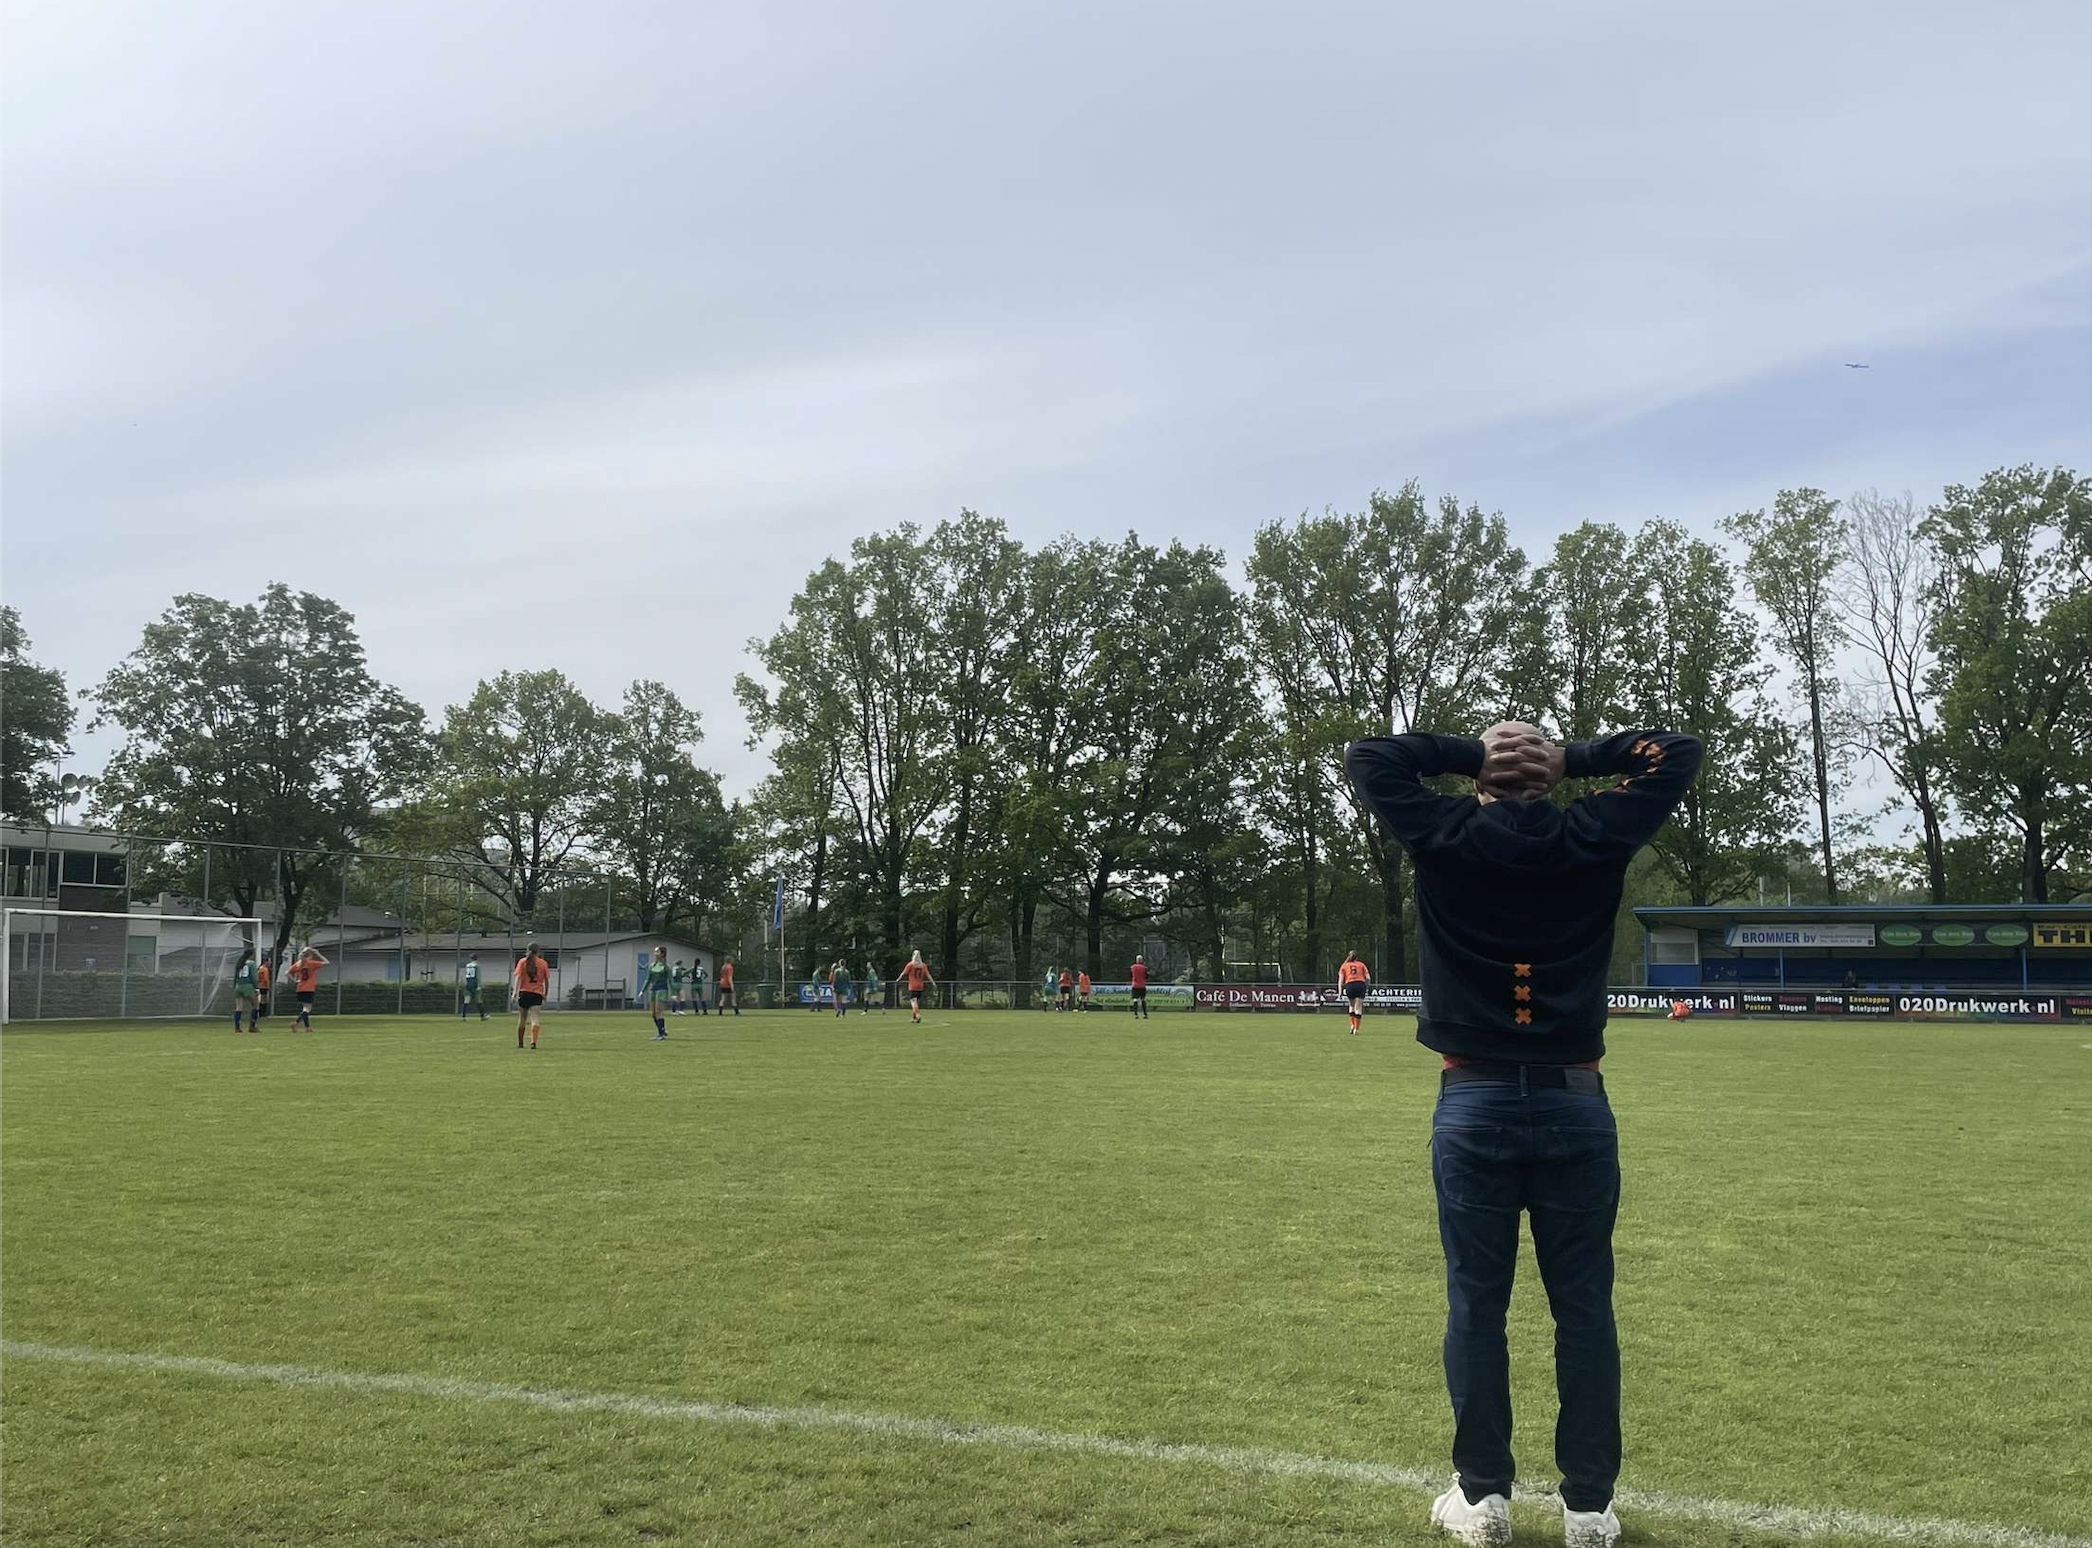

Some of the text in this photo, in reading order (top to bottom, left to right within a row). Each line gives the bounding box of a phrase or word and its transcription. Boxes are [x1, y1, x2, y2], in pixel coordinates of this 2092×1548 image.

[1742, 932, 1799, 943] BROMMER
[1803, 932, 1816, 943] bv
[2038, 930, 2092, 943] TH
[1196, 989, 1225, 1002] Café
[1229, 990, 1248, 1002] De
[1371, 988, 1422, 996] ACHTERI
[1743, 994, 1773, 1002] Stickers
[1779, 1004, 1807, 1012] Vlaggen
[1849, 1005, 1890, 1013] Briefpapier
